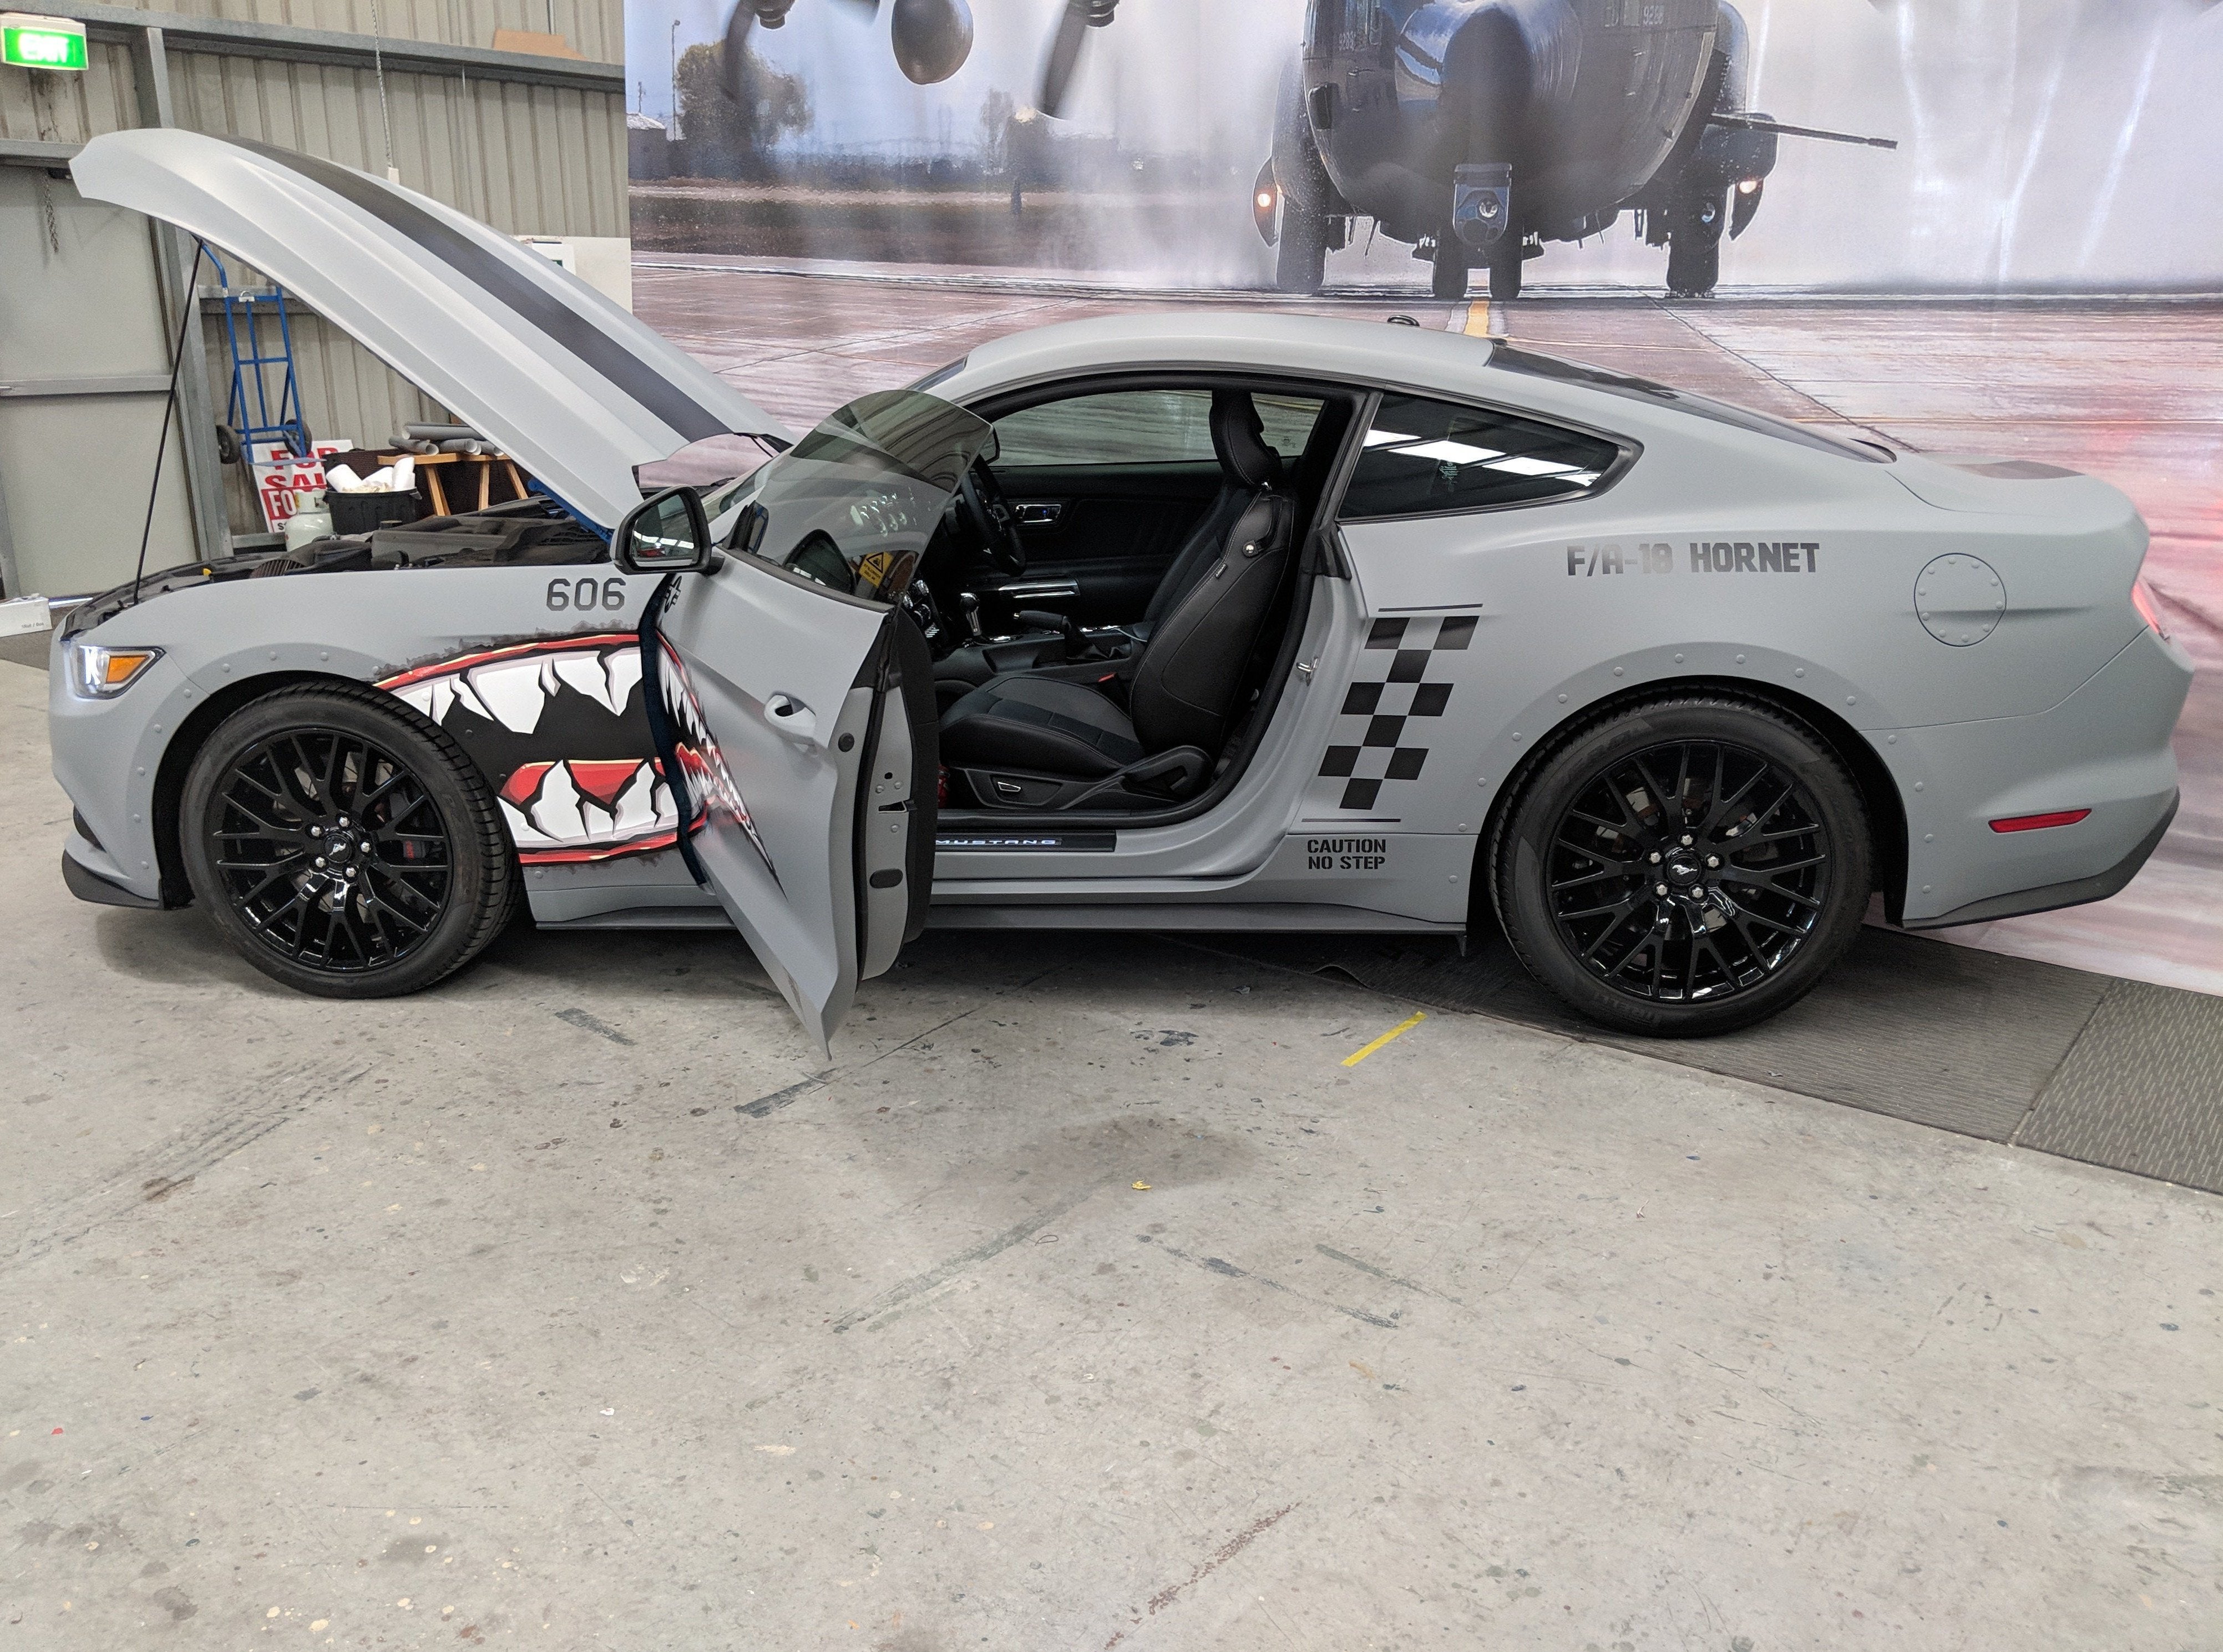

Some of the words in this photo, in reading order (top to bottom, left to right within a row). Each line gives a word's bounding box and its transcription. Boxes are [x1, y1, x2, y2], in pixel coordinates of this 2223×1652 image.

[265, 473, 324, 488] SAL
[268, 490, 298, 516] FO
[1567, 543, 1673, 577] F/A-18
[1689, 543, 1820, 572] HORNET
[546, 577, 626, 611] 606
[1307, 839, 1386, 853] CAUTION
[1308, 856, 1333, 869] NO
[1340, 856, 1385, 869] STEP
